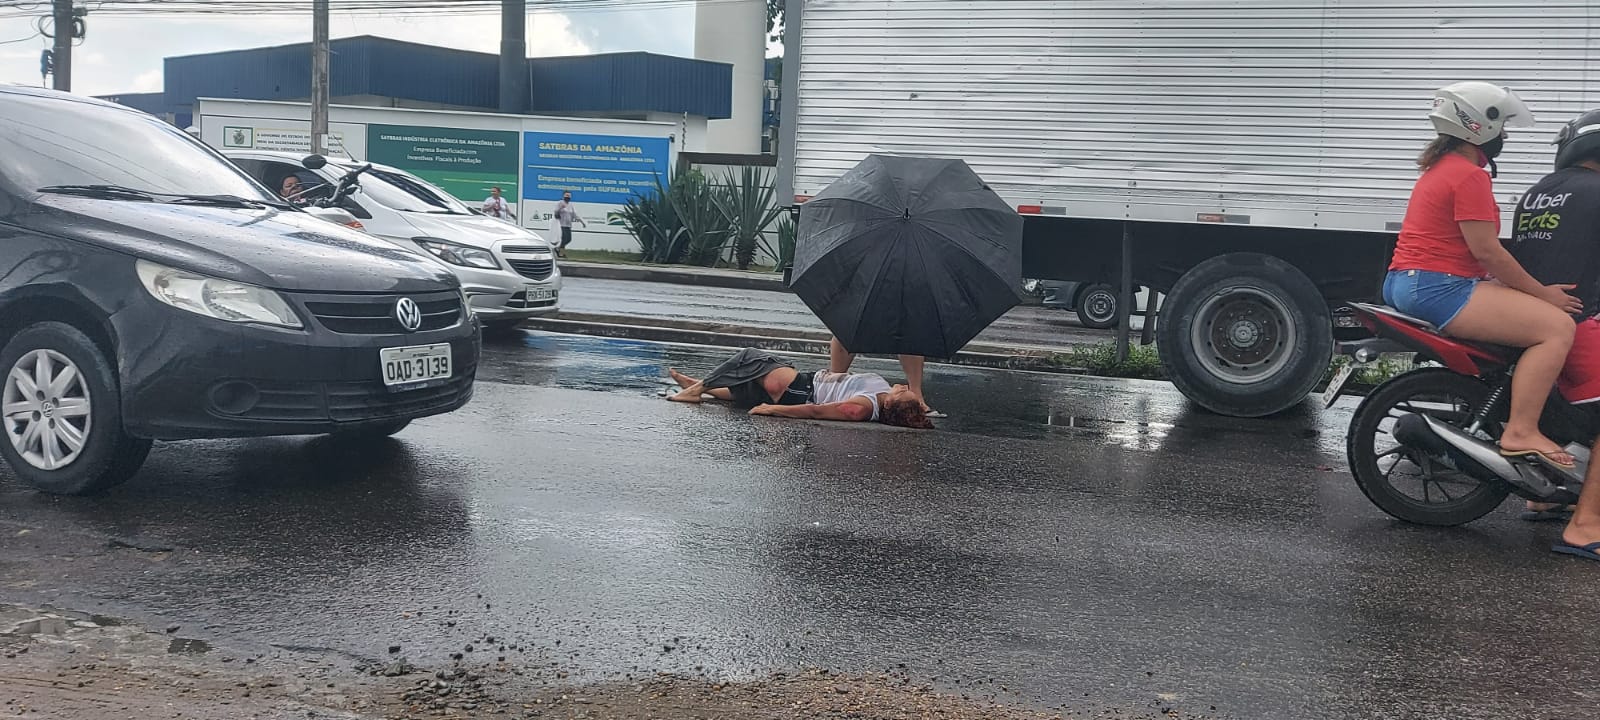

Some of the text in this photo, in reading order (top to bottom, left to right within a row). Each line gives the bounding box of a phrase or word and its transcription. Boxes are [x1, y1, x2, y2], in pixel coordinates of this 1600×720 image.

[538, 142, 642, 154] SATBRAS DA AMAZÔNIA
[1522, 192, 1572, 210] Uber
